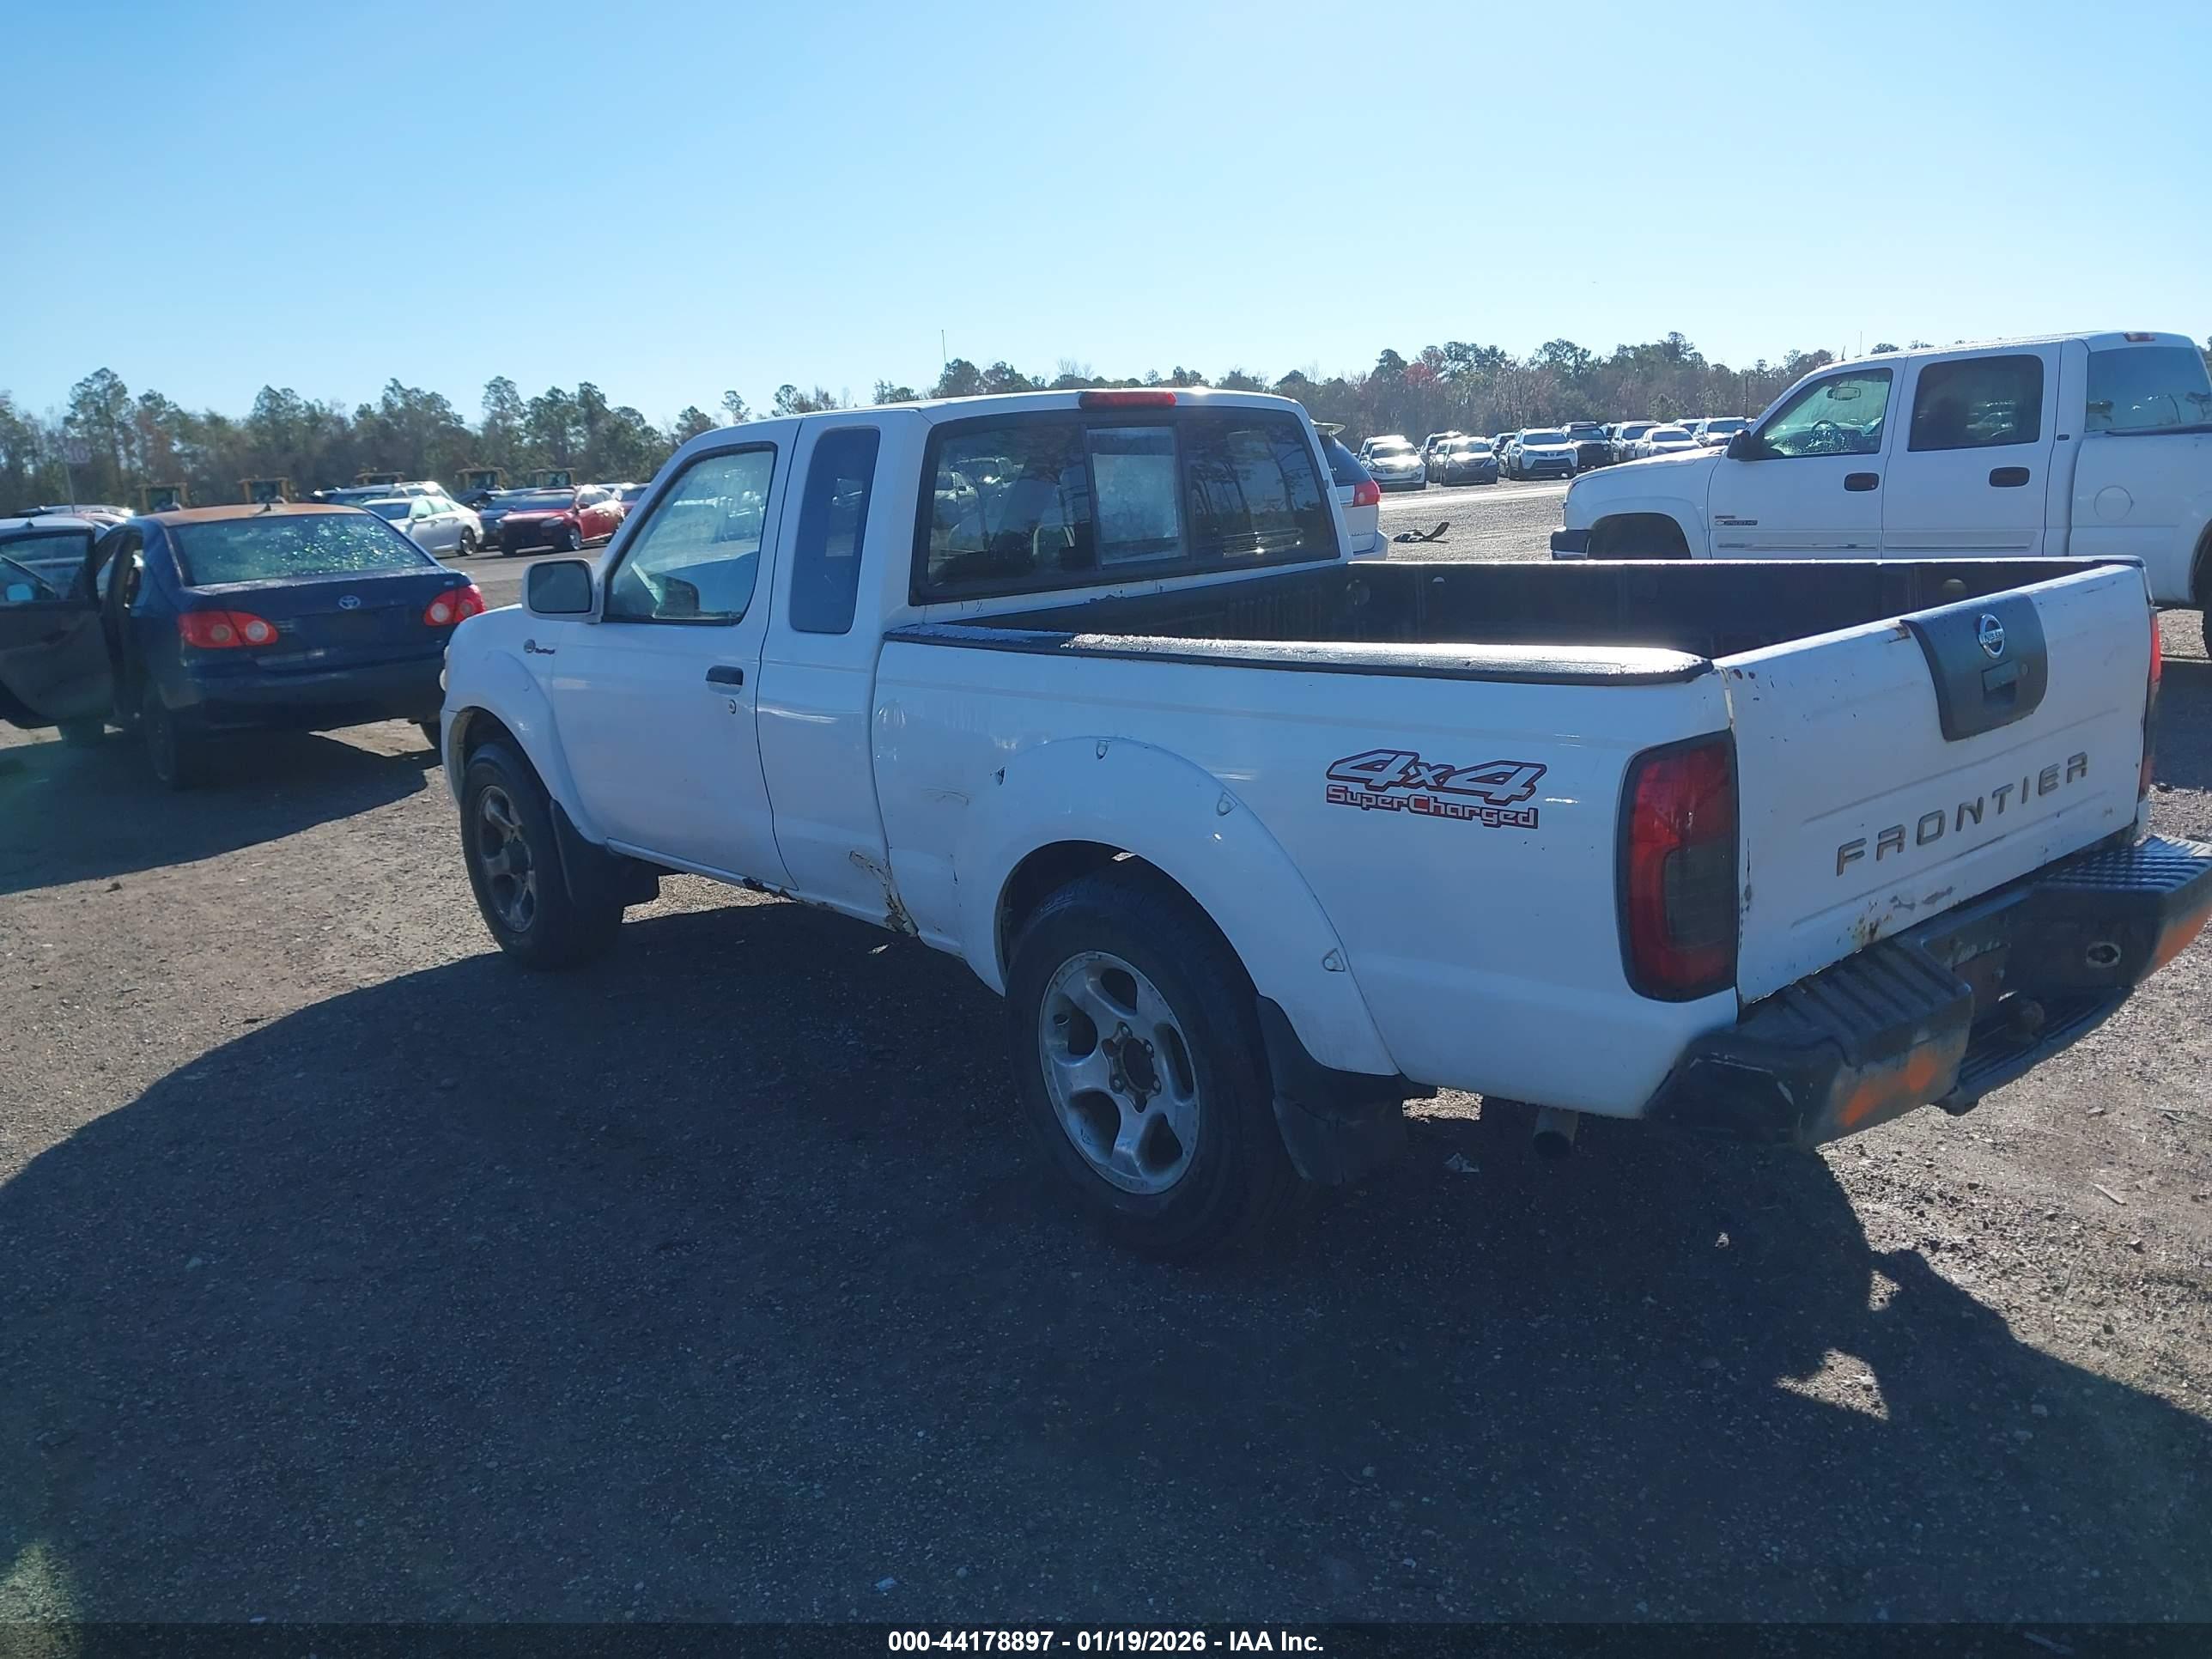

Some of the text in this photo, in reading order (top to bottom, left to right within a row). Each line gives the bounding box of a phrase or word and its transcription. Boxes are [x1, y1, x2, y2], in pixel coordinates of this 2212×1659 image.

[1325, 748, 1548, 806] 4x4
[1325, 783, 1540, 830] SuperCharged
[1835, 750, 2089, 878] FRONTIER
